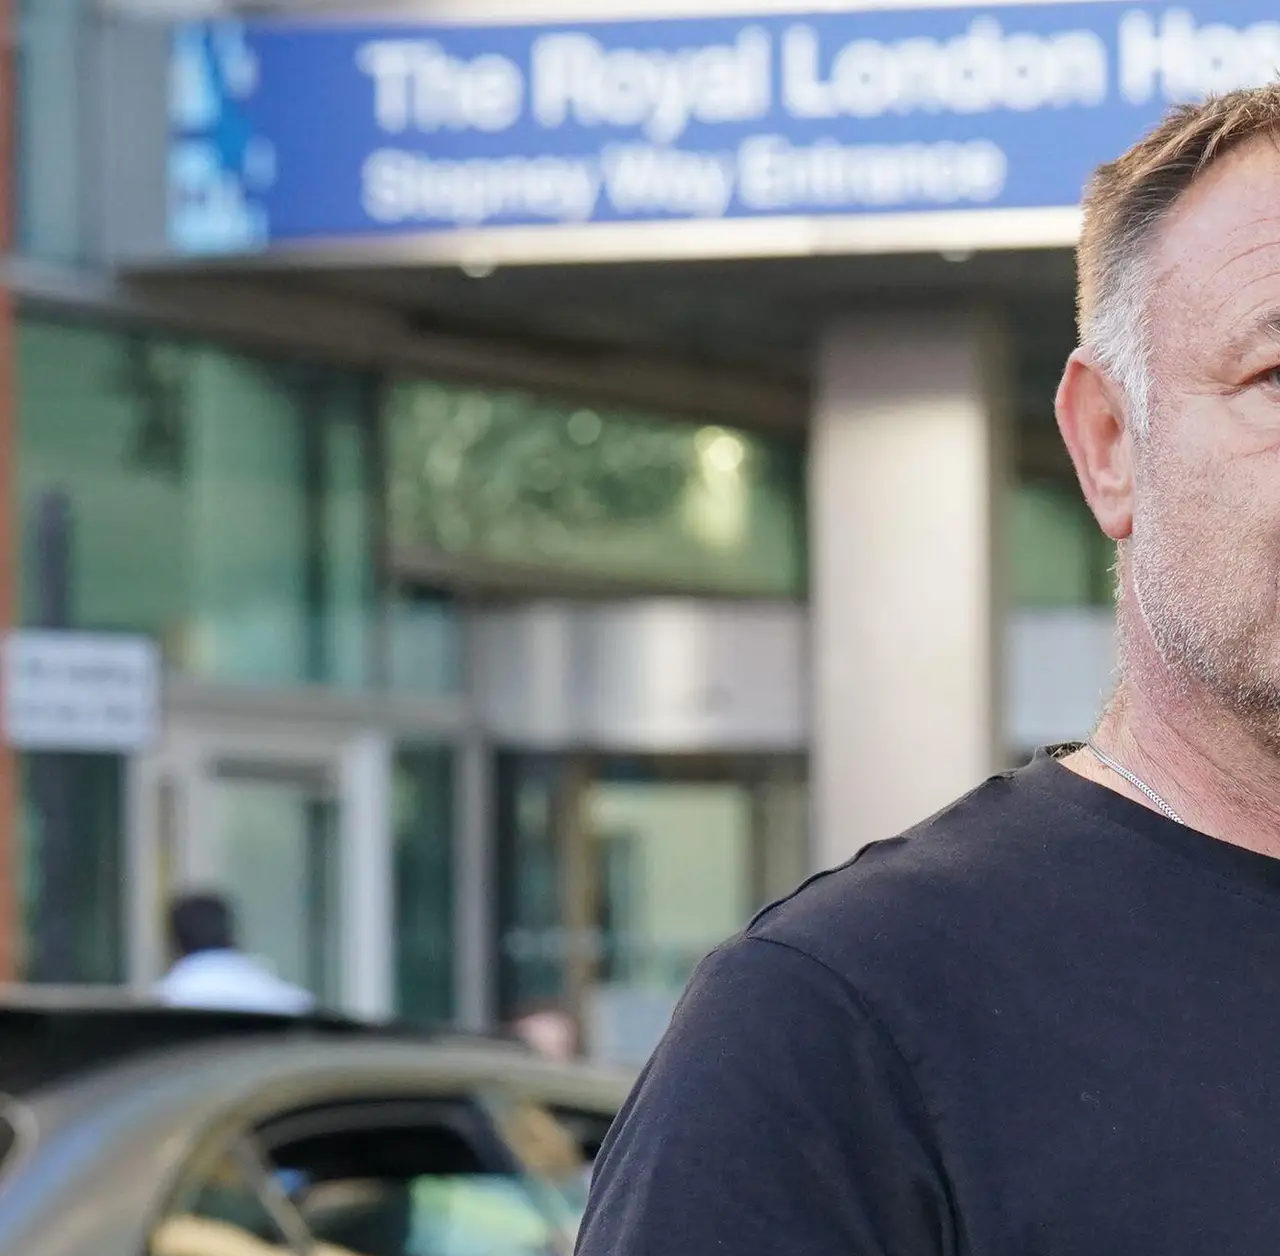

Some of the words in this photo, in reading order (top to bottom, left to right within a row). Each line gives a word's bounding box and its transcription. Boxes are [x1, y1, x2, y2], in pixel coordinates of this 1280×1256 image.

[360, 39, 522, 133] The
[531, 31, 770, 142] Royal
[782, 23, 1106, 118] London
